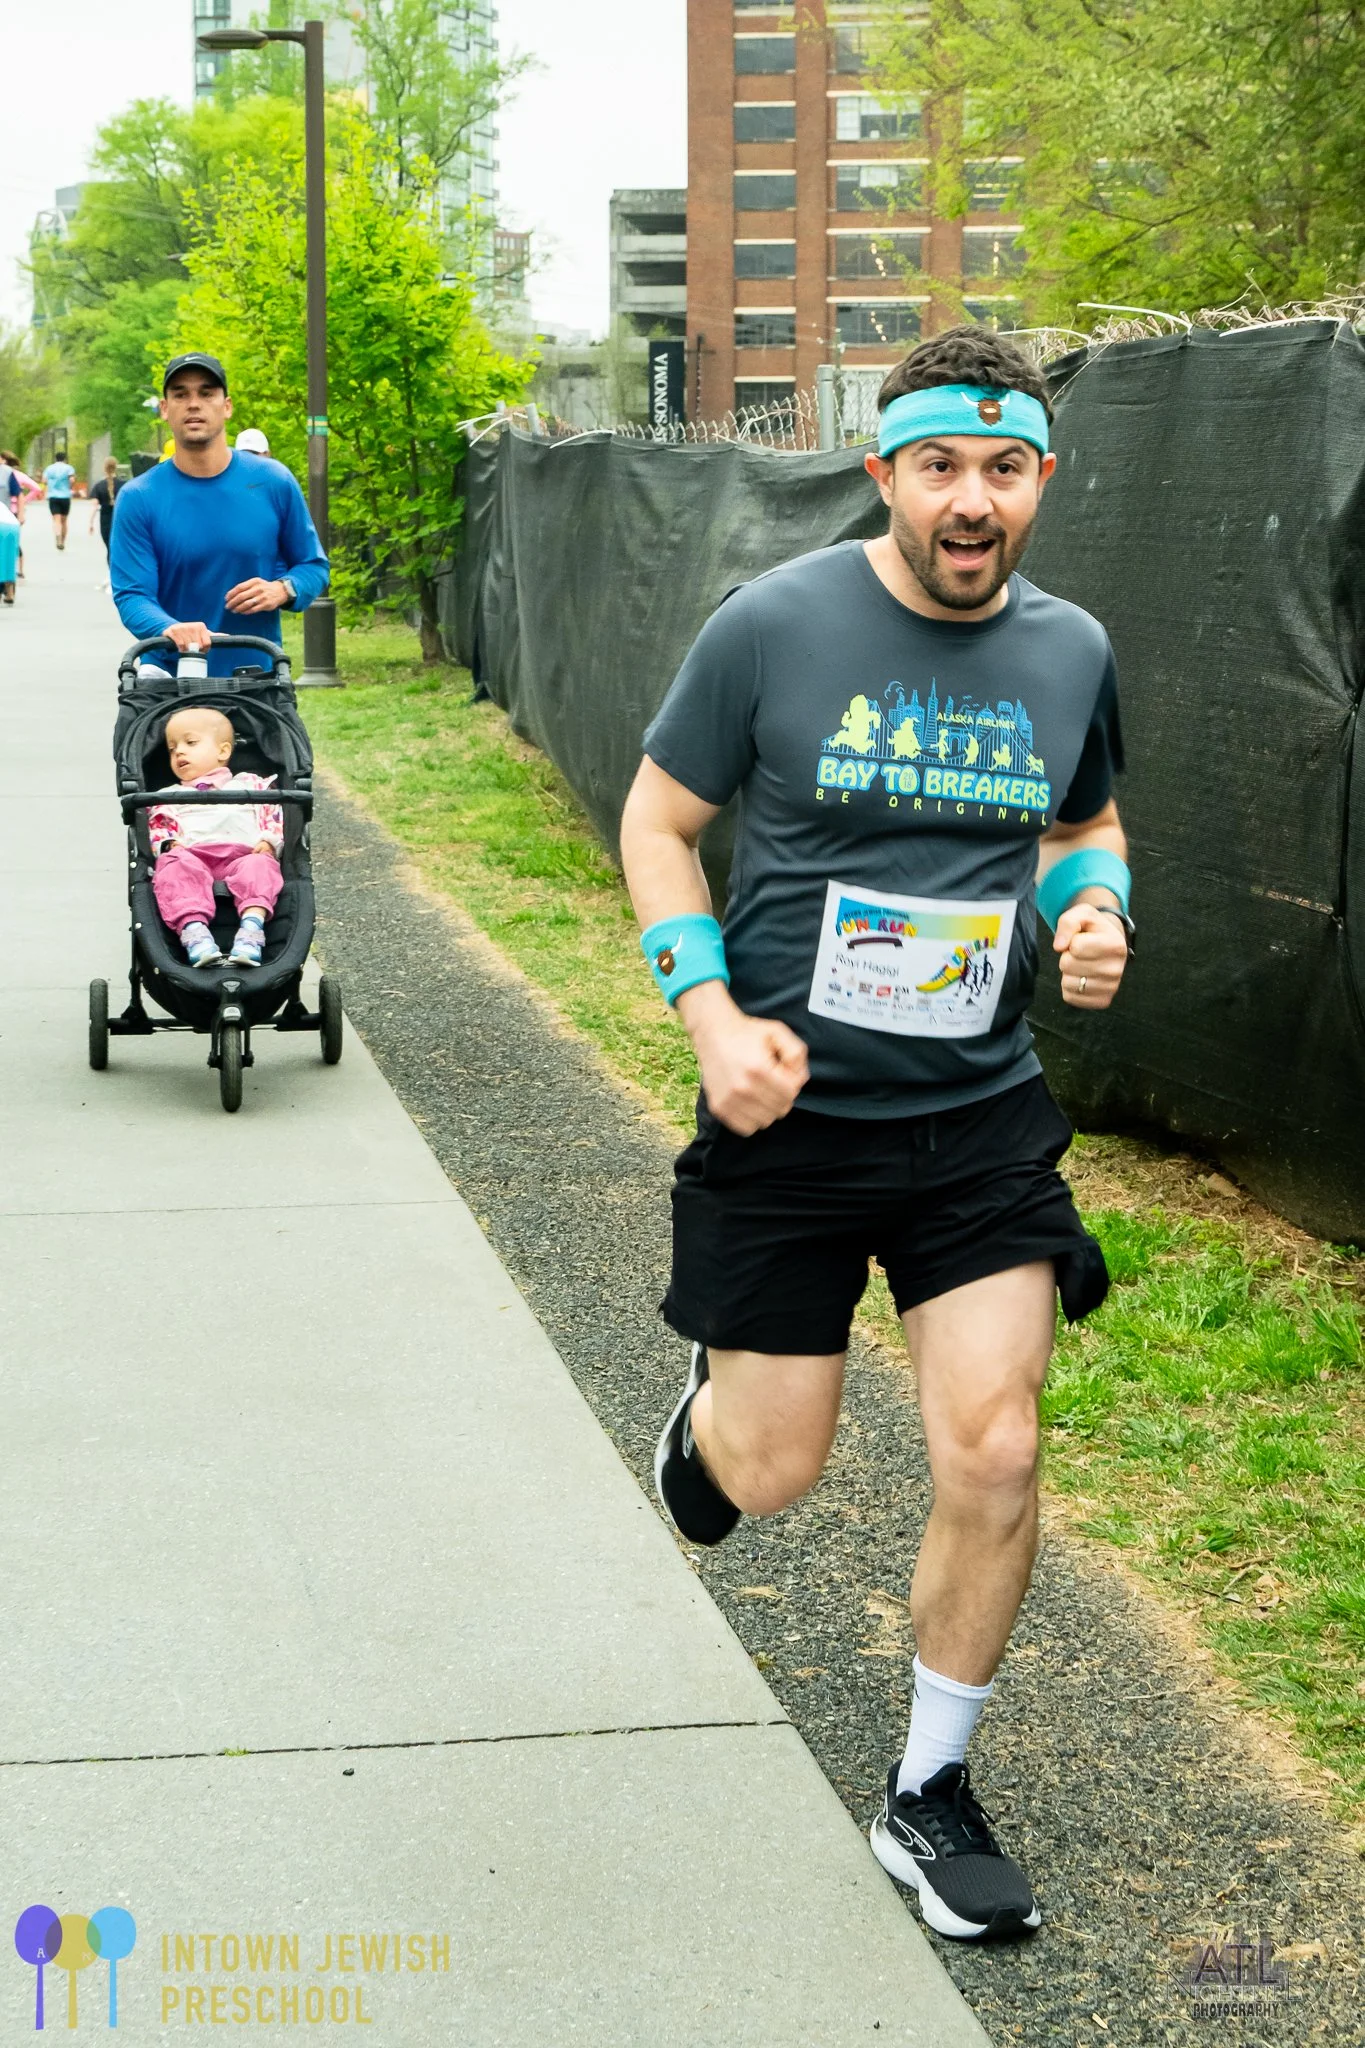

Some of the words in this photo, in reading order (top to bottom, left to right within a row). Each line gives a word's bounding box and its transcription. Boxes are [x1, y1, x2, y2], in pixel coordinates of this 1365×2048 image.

[937, 712, 974, 725] ALASKA
[976, 716, 1016, 731] AIRLINES
[818, 757, 877, 789] BAY
[882, 765, 919, 794] TO
[925, 768, 1051, 810] BREAKERS
[815, 787, 850, 804] BE
[888, 796, 1047, 827] ORIGINAL
[878, 917, 919, 938] RUN
